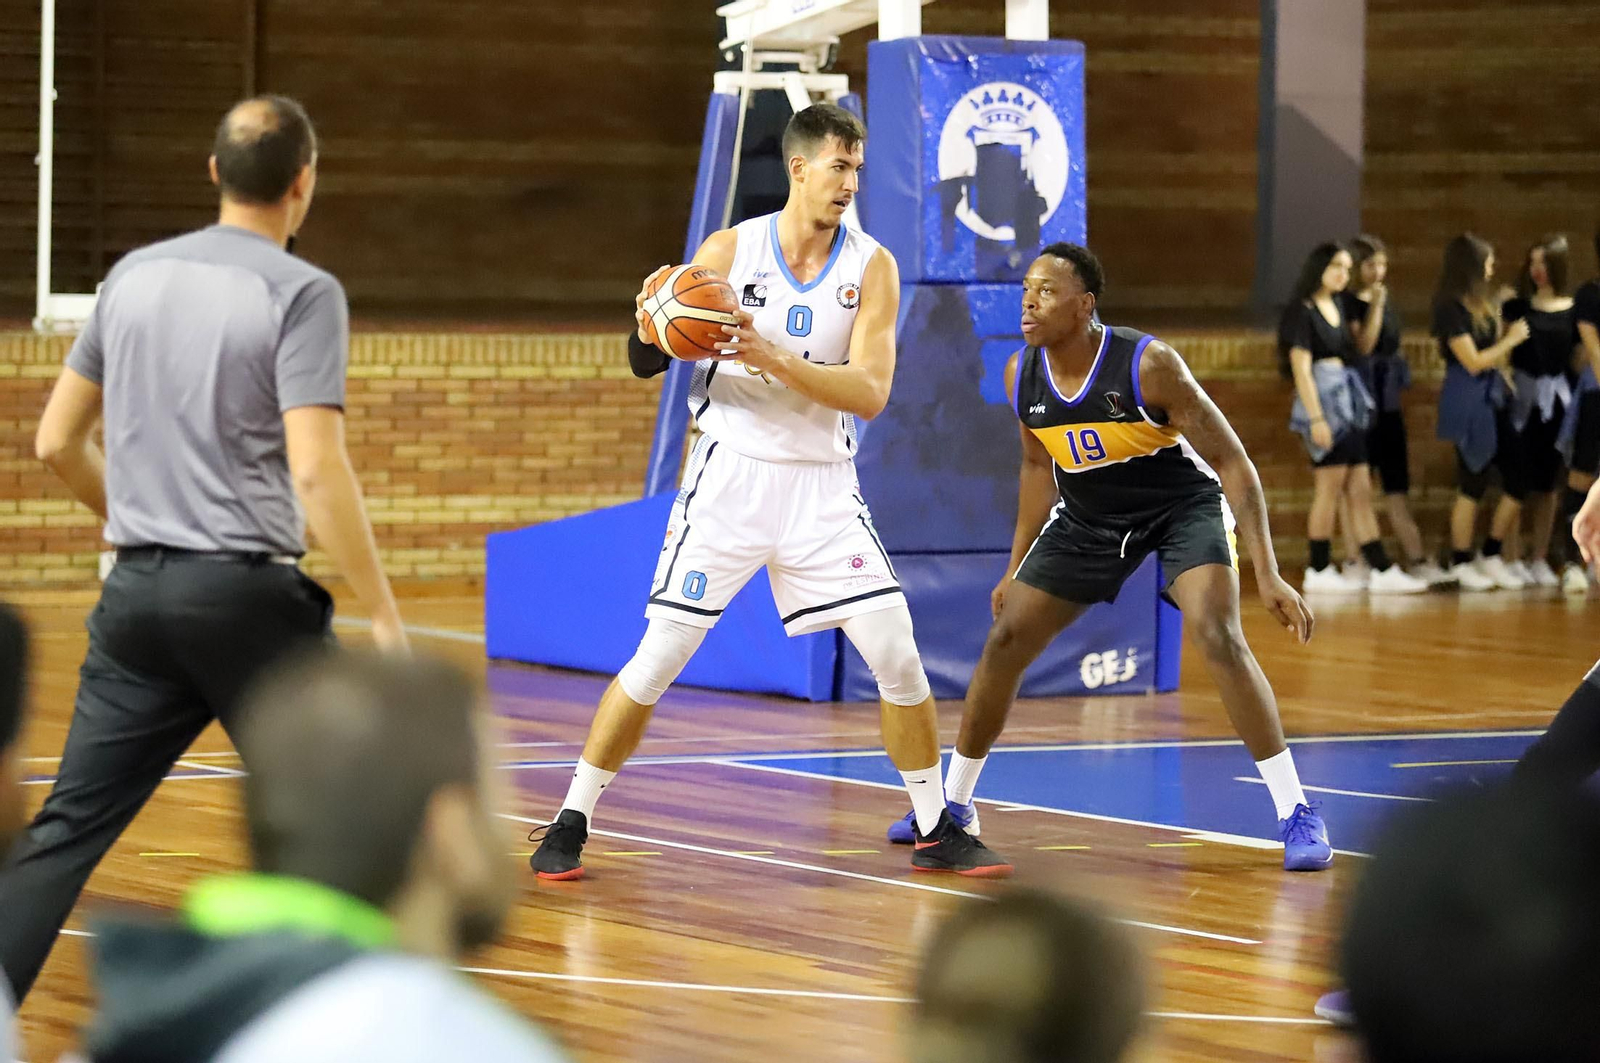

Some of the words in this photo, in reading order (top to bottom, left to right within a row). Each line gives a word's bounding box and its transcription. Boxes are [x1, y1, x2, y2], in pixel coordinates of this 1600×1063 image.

[743, 298, 761, 306] EBA
[786, 305, 813, 337] 0
[1064, 428, 1107, 466] 19
[681, 570, 708, 601] 0
